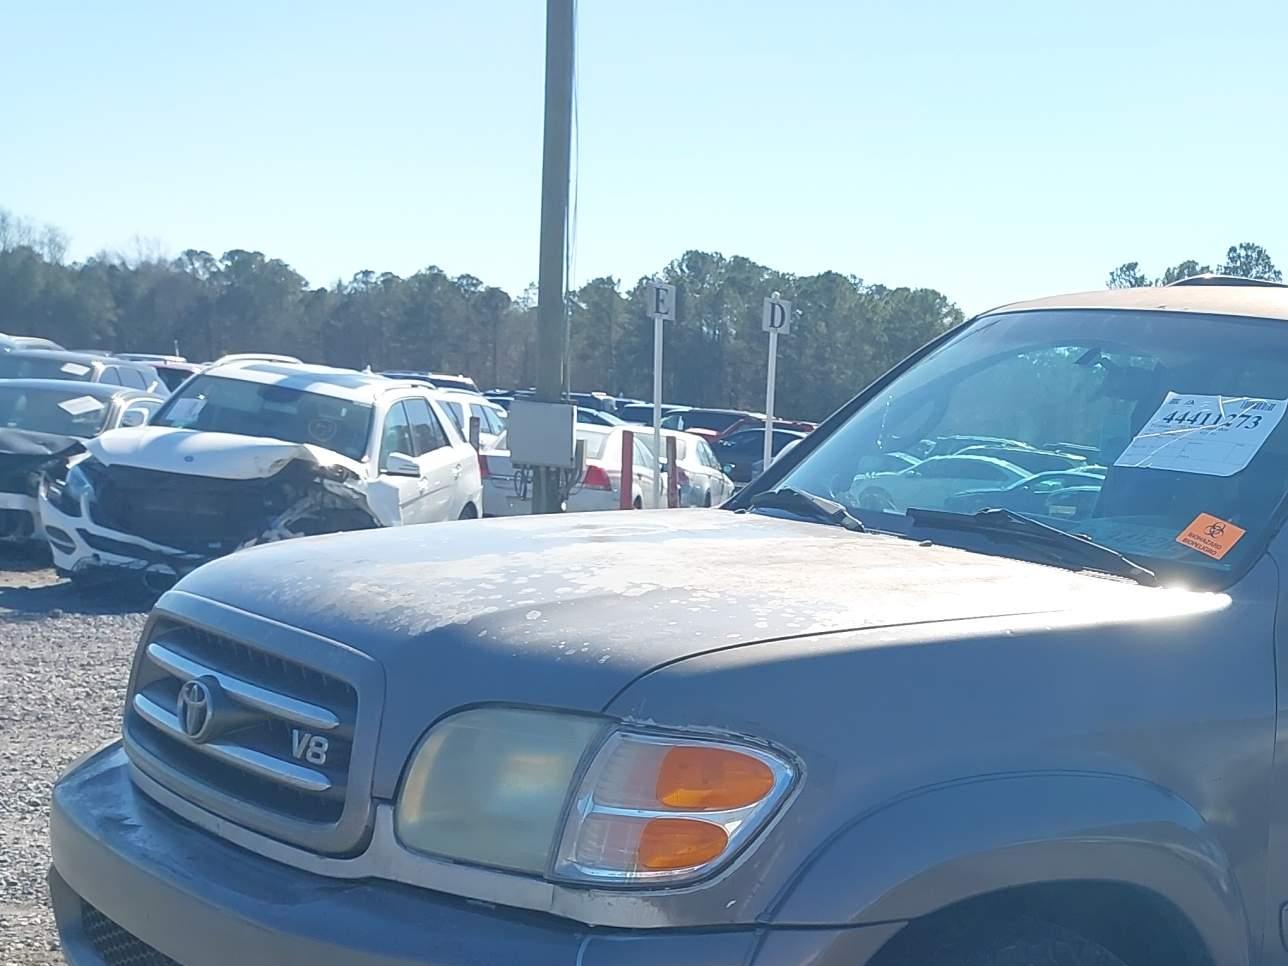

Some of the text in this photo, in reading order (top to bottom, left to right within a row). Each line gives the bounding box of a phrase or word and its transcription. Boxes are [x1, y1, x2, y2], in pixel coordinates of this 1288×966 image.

[654, 287, 669, 315] E
[769, 302, 786, 329] D
[1163, 411, 1262, 429] 44411273
[292, 729, 329, 765] V8
